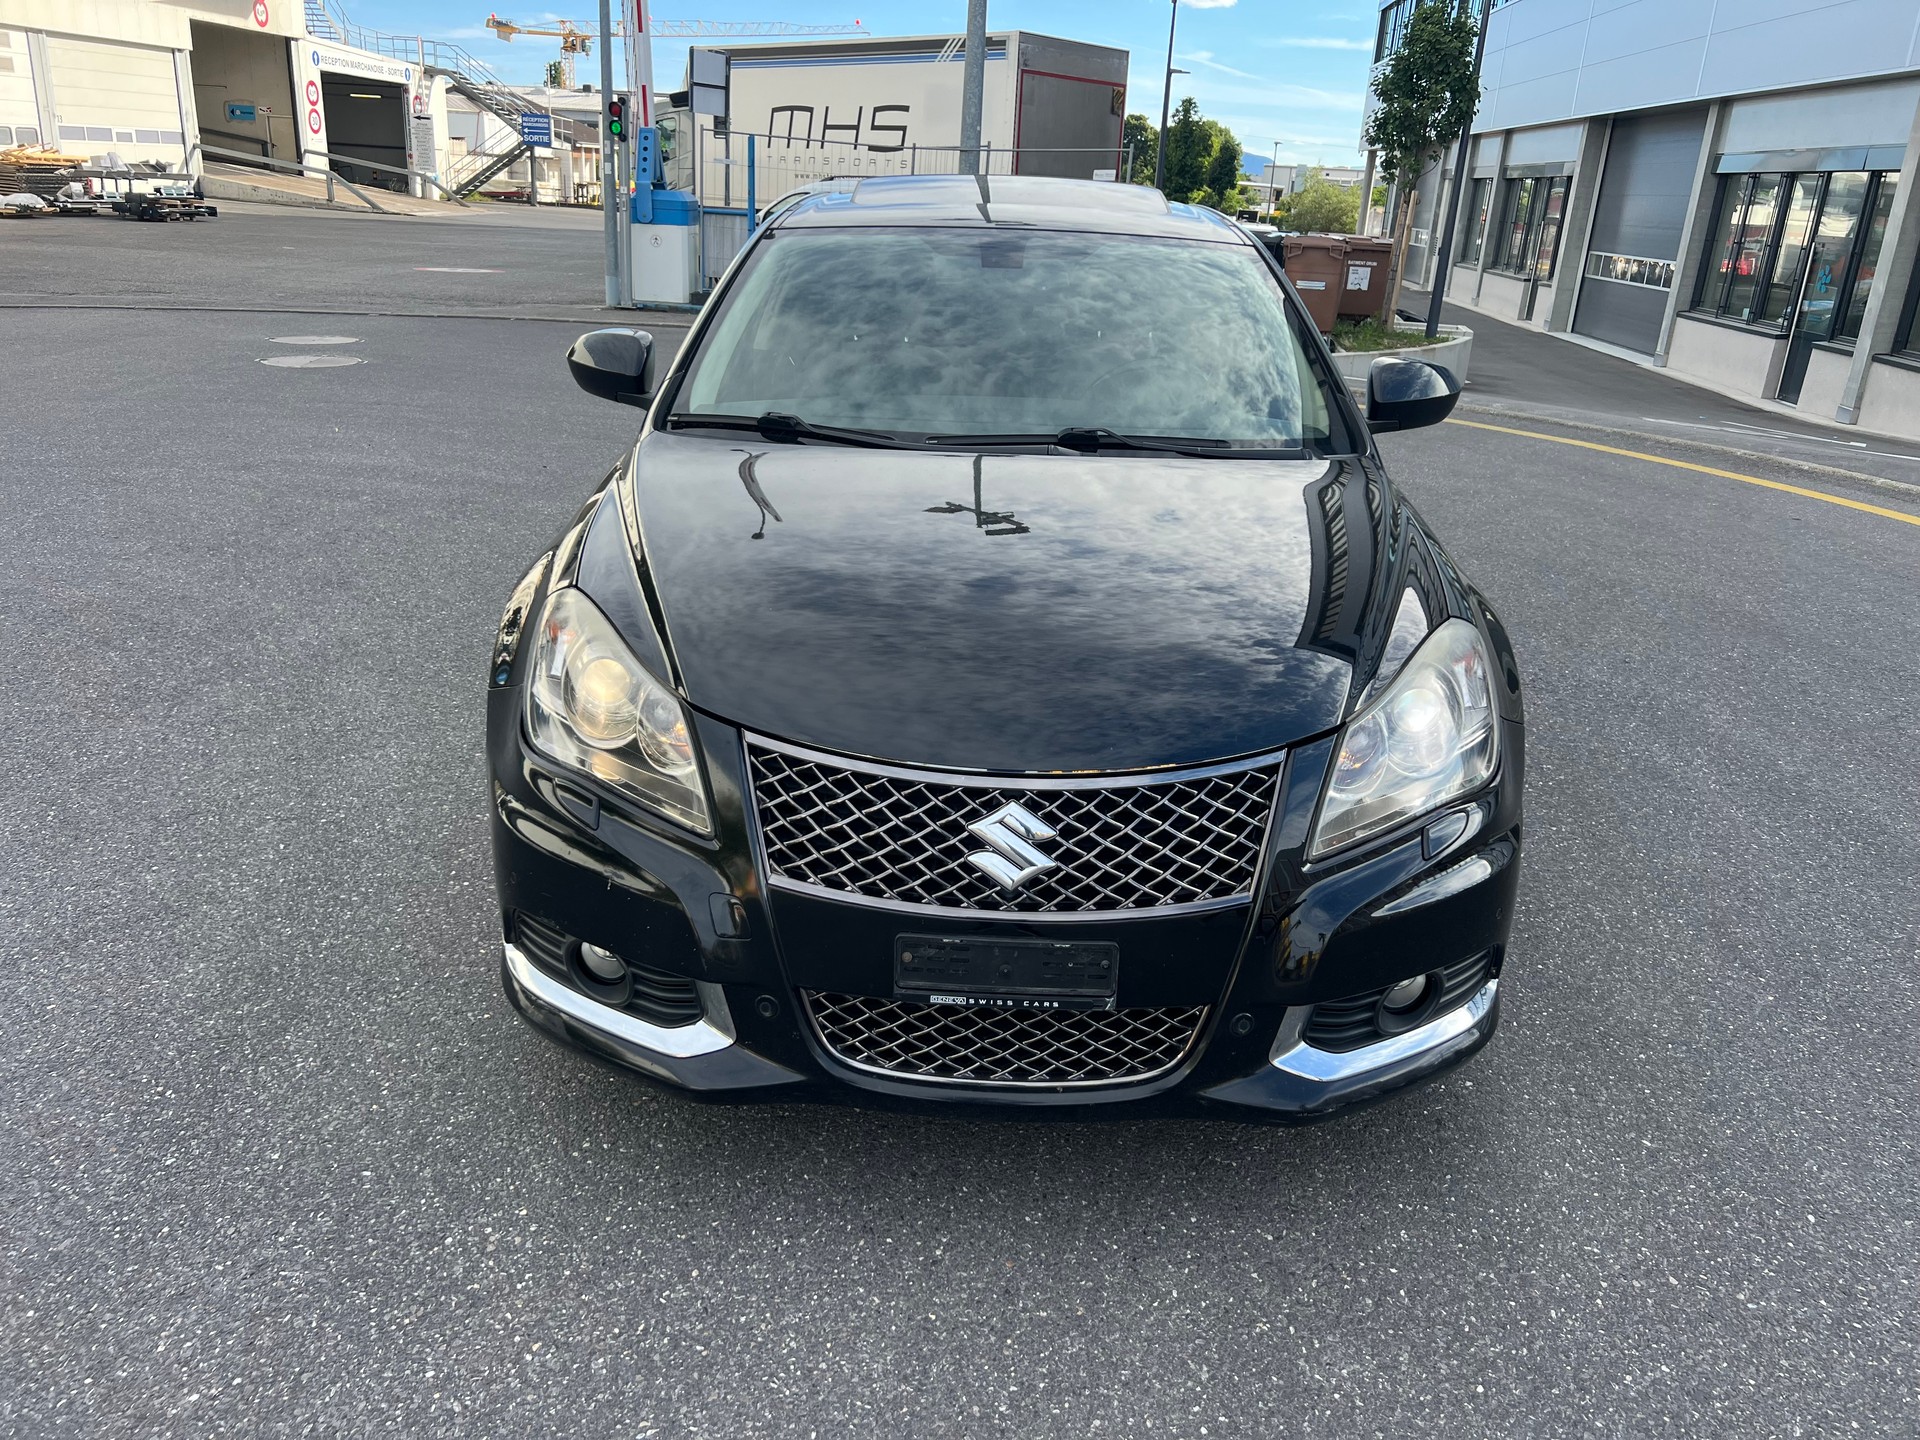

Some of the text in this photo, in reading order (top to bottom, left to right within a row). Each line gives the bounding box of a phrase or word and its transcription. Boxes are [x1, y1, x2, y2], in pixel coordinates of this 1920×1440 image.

[320, 55, 349, 68] RECEPTION
[350, 60, 384, 74] MARCHANDISE
[387, 67, 404, 77] SORTIE
[767, 105, 910, 153] MHS
[523, 134, 550, 143] SORTIE
[767, 155, 908, 169] TRANSPORTS
[931, 995, 1060, 1008] GENEVA SWISS CARS
